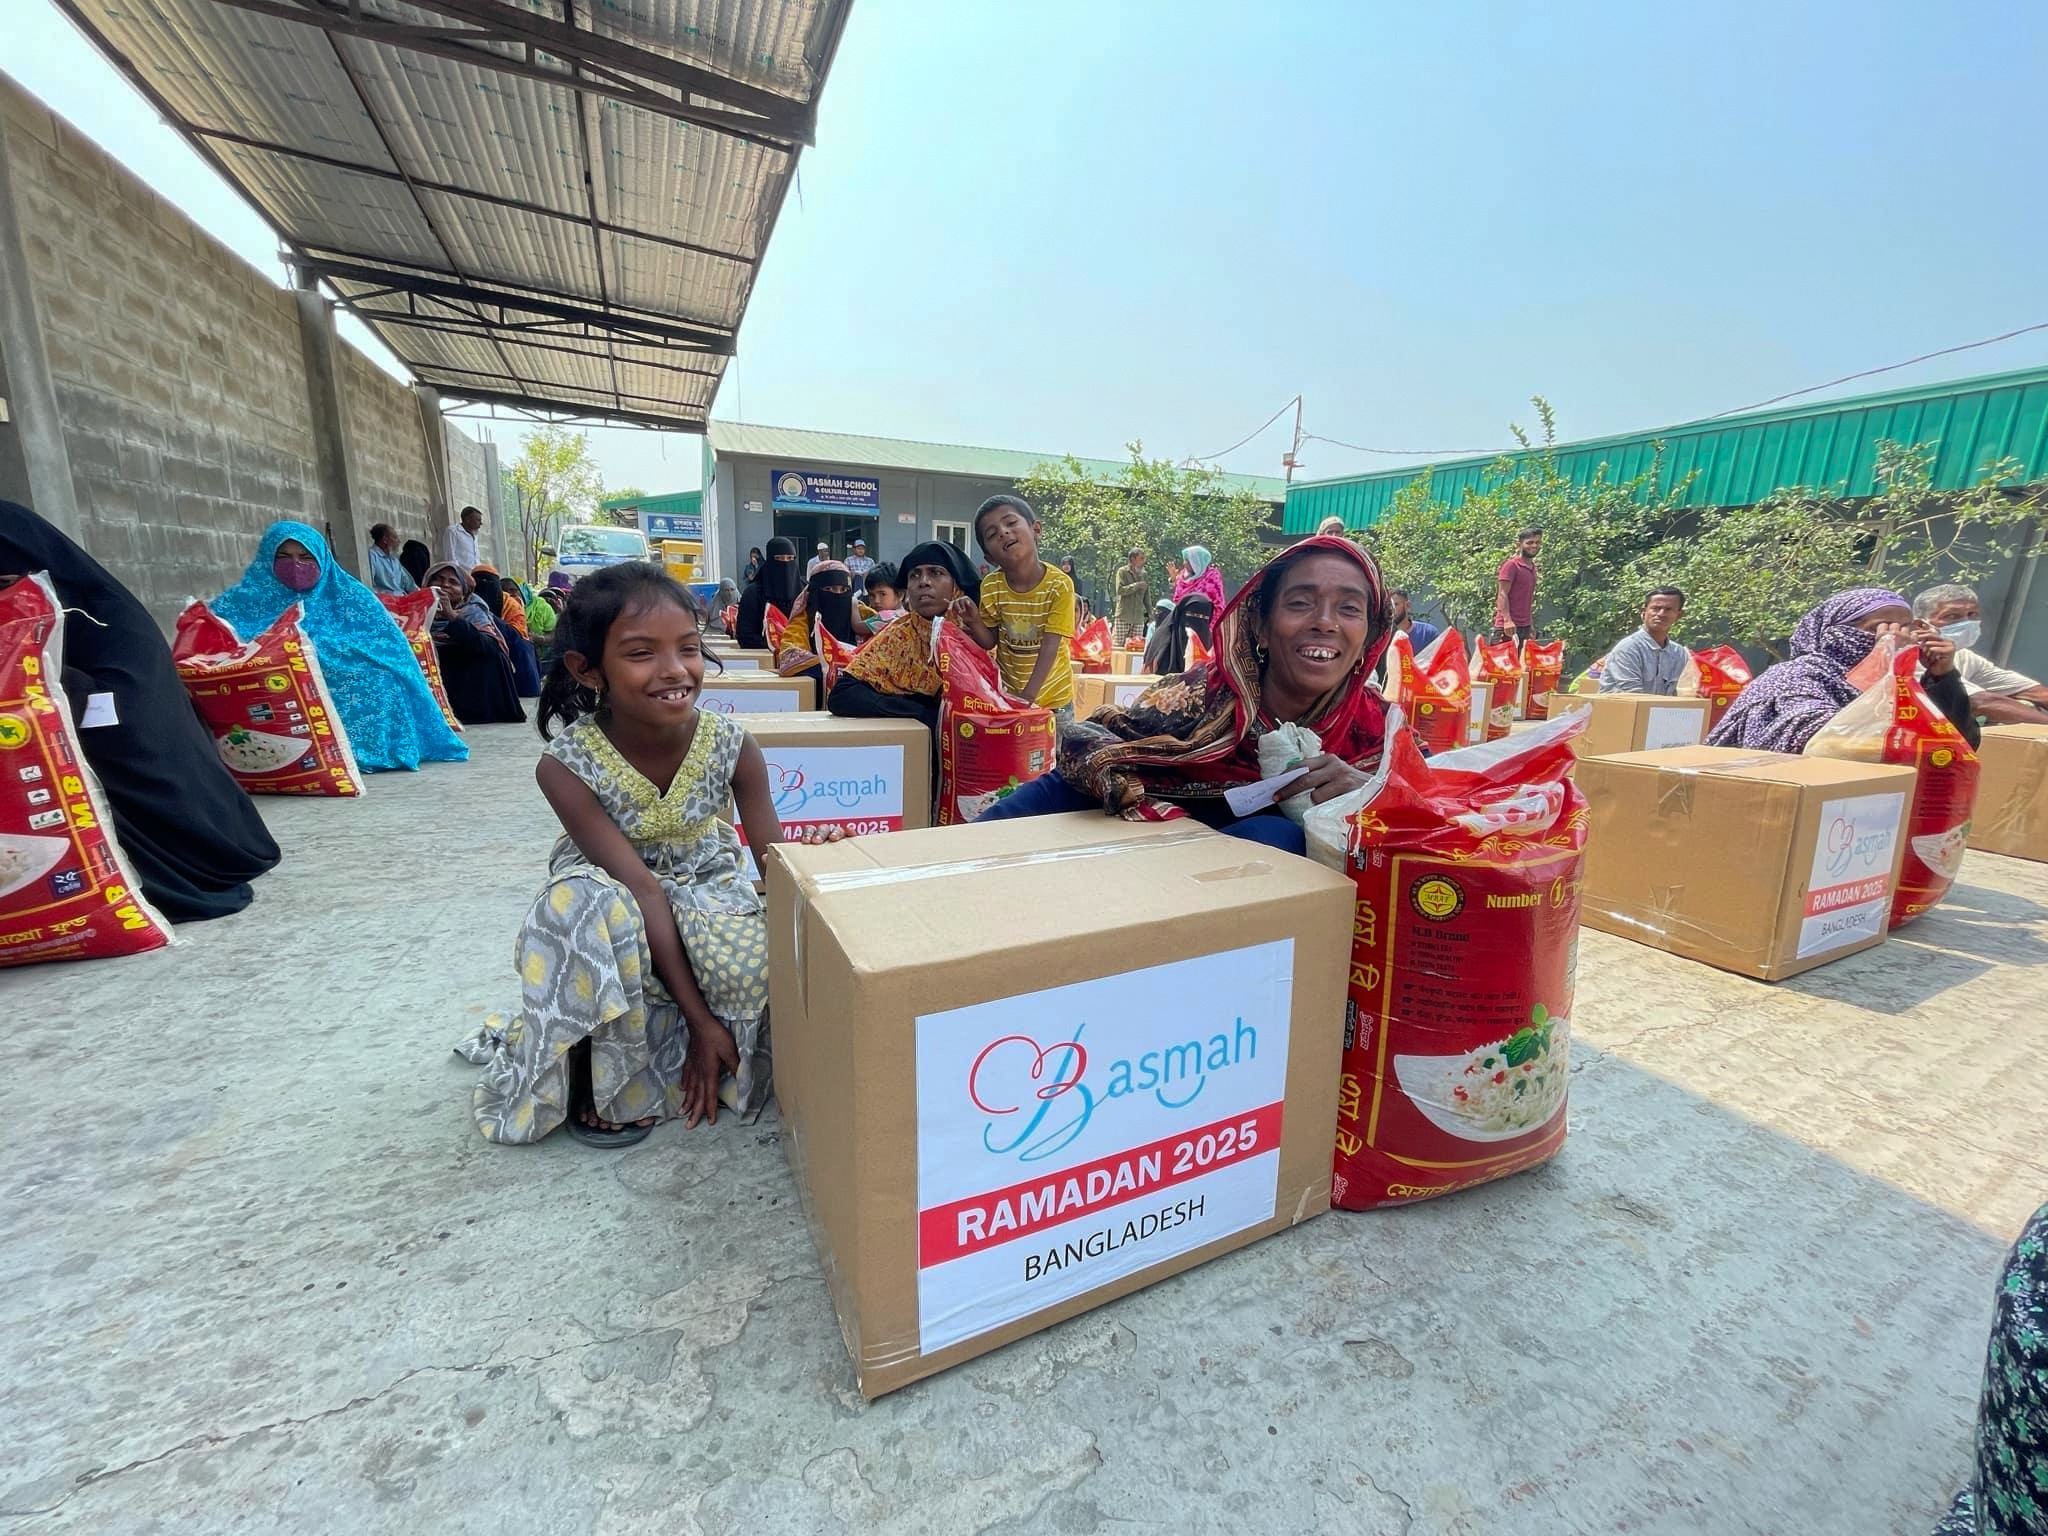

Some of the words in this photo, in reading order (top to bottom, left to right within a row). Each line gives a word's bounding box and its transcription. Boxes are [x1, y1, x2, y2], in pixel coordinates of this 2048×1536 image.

[807, 477, 843, 488] BASMAH
[844, 480, 878, 491] SCHOOL
[309, 705, 331, 736] M.B
[62, 775, 97, 828] M.B
[767, 763, 887, 815] Basmah
[105, 884, 148, 930] M.B
[1486, 893, 1544, 909] Number
[1812, 887, 1860, 911] RAMADAN
[1861, 879, 1884, 898] 2025
[1821, 912, 1867, 936] BANGLADESH
[968, 1017, 1258, 1162] Basmah
[957, 1150, 1163, 1248] RAMADAN
[1172, 1119, 1258, 1176] 2025
[1025, 1194, 1205, 1282] BANGLADESH
